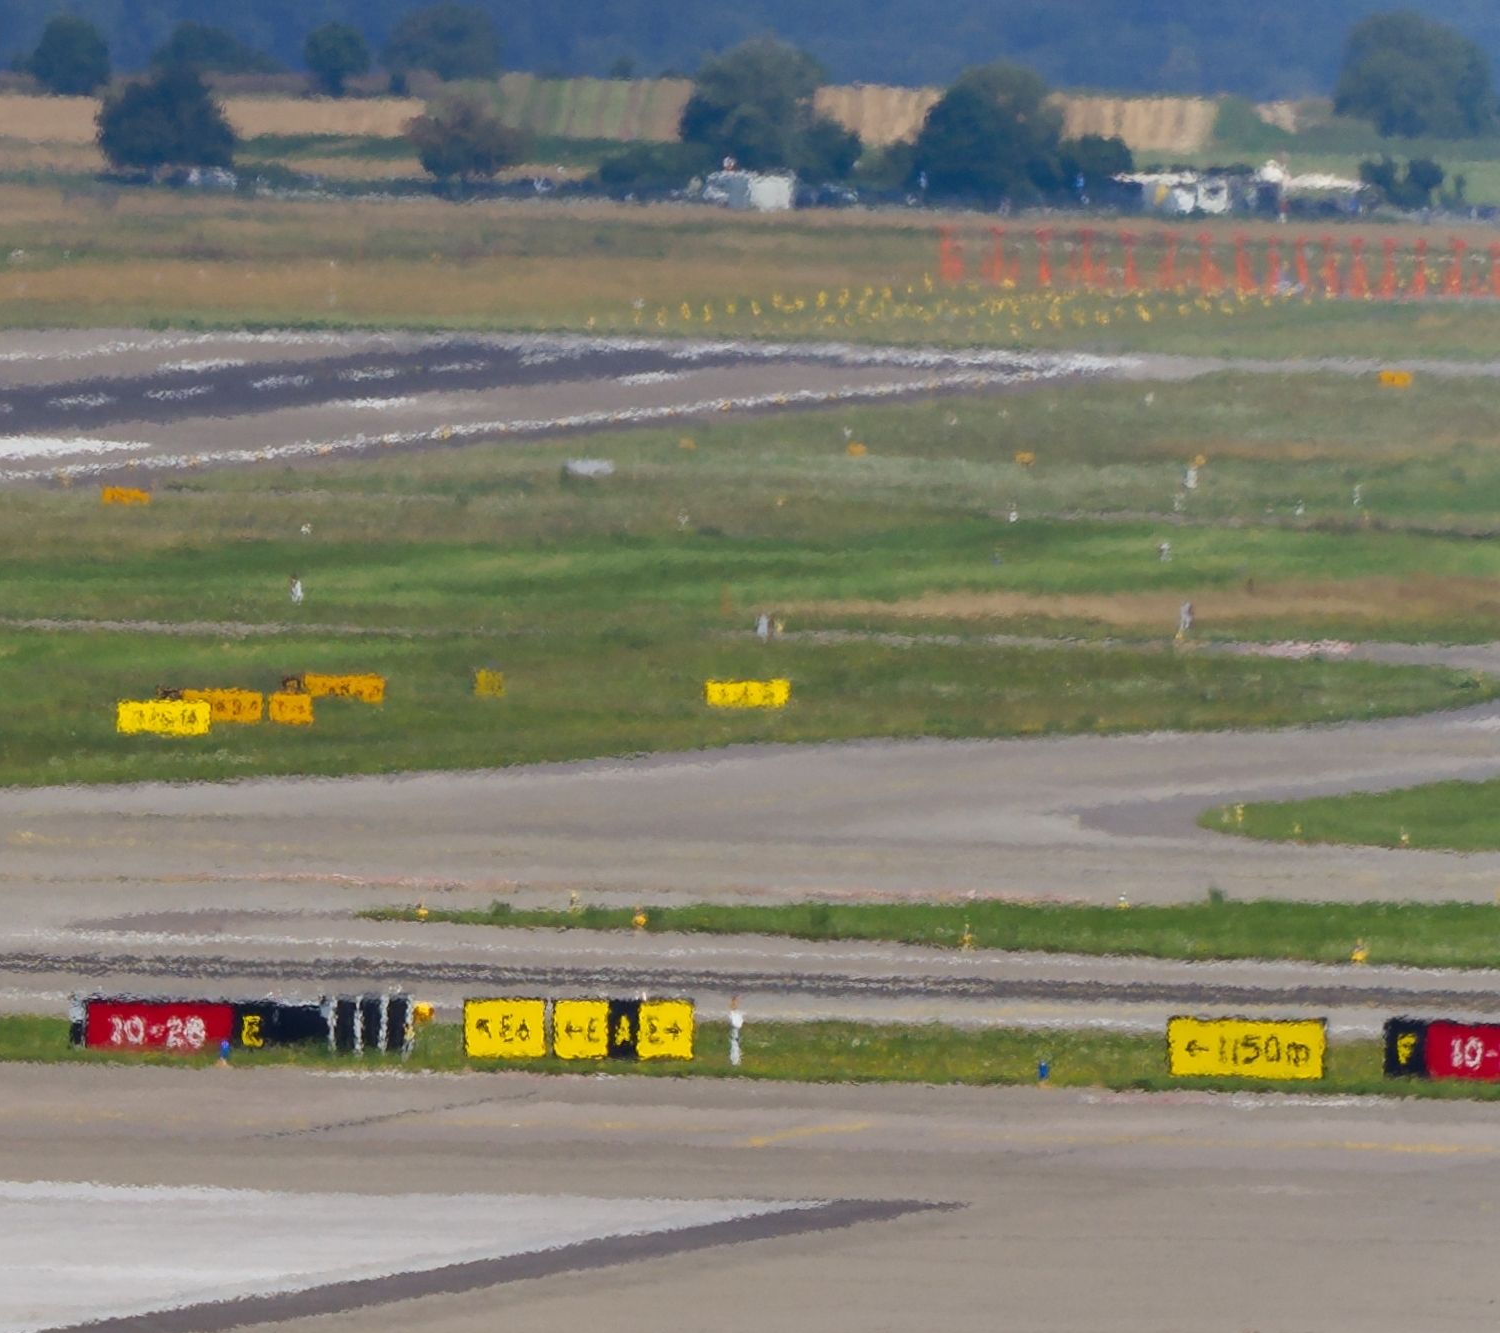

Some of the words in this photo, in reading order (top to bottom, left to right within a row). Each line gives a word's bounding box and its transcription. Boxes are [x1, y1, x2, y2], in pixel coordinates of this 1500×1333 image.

[108, 1014, 207, 1048] 10-28
[241, 1015, 264, 1048] E
[614, 1015, 632, 1046] A
